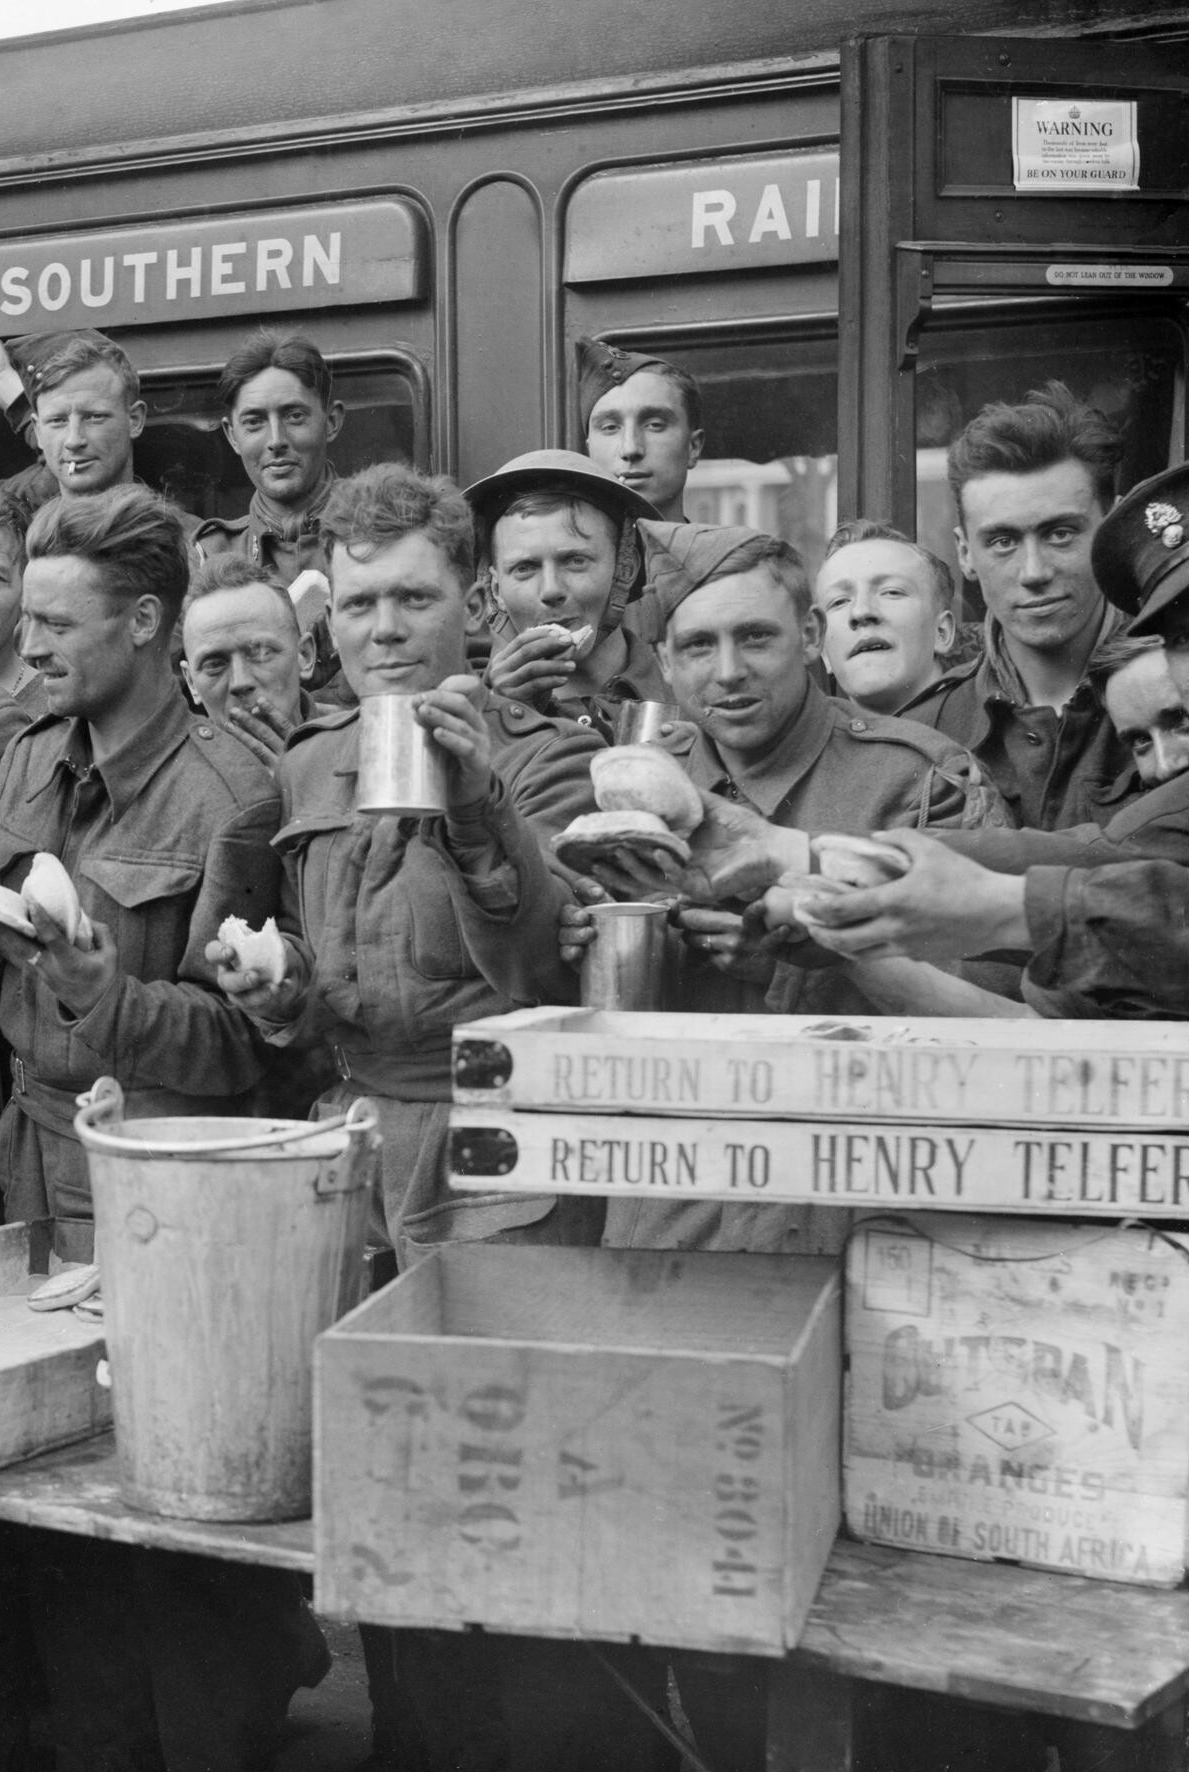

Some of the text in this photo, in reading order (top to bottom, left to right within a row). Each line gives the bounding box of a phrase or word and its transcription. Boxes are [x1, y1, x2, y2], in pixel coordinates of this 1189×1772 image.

[1036, 121, 1113, 136] WARNING
[1027, 169, 1126, 179] BE ON YOUR GUARD
[691, 177, 840, 248] RAI
[0, 232, 341, 316] SOUTHERN
[1066, 271, 1079, 279] NOT
[1080, 271, 1097, 279] LEAN
[1098, 271, 1112, 279] OUT
[1138, 271, 1165, 280] WINDOW
[553, 1053, 701, 1102] RETURN
[727, 1058, 774, 1103] TO
[814, 1048, 979, 1110] HENRY
[550, 1133, 1189, 1205] RETURN TO HENRY TELFER
[863, 1502, 928, 1542] UNION
[973, 1520, 1051, 1560] SOUTH
[1059, 1533, 1151, 1577] AFRICA
